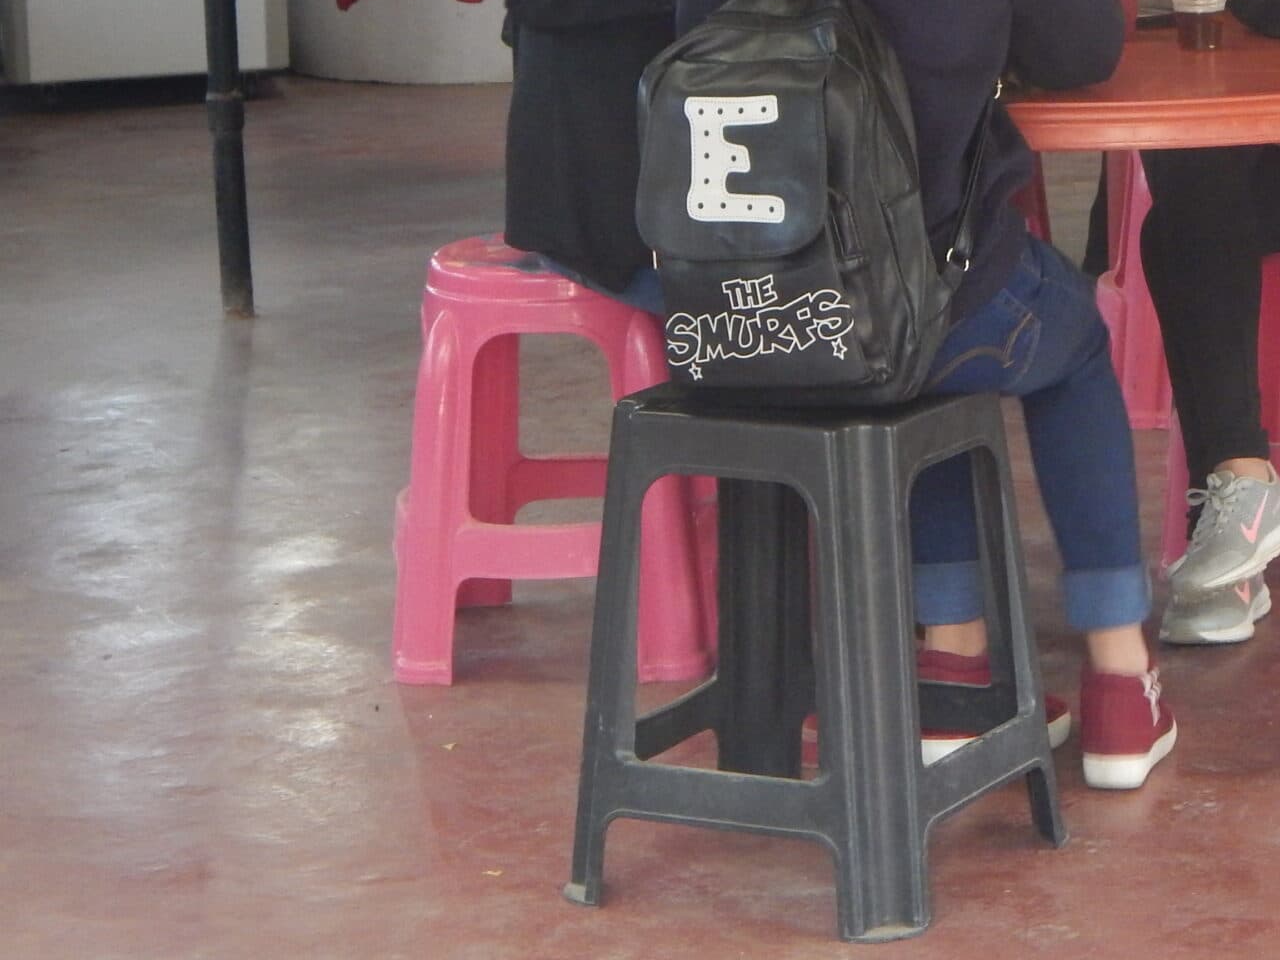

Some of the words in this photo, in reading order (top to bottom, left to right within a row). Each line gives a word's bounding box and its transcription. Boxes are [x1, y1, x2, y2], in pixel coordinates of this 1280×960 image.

[683, 95, 785, 223] E
[665, 289, 854, 366] SMURFS
[722, 274, 777, 310] THE
